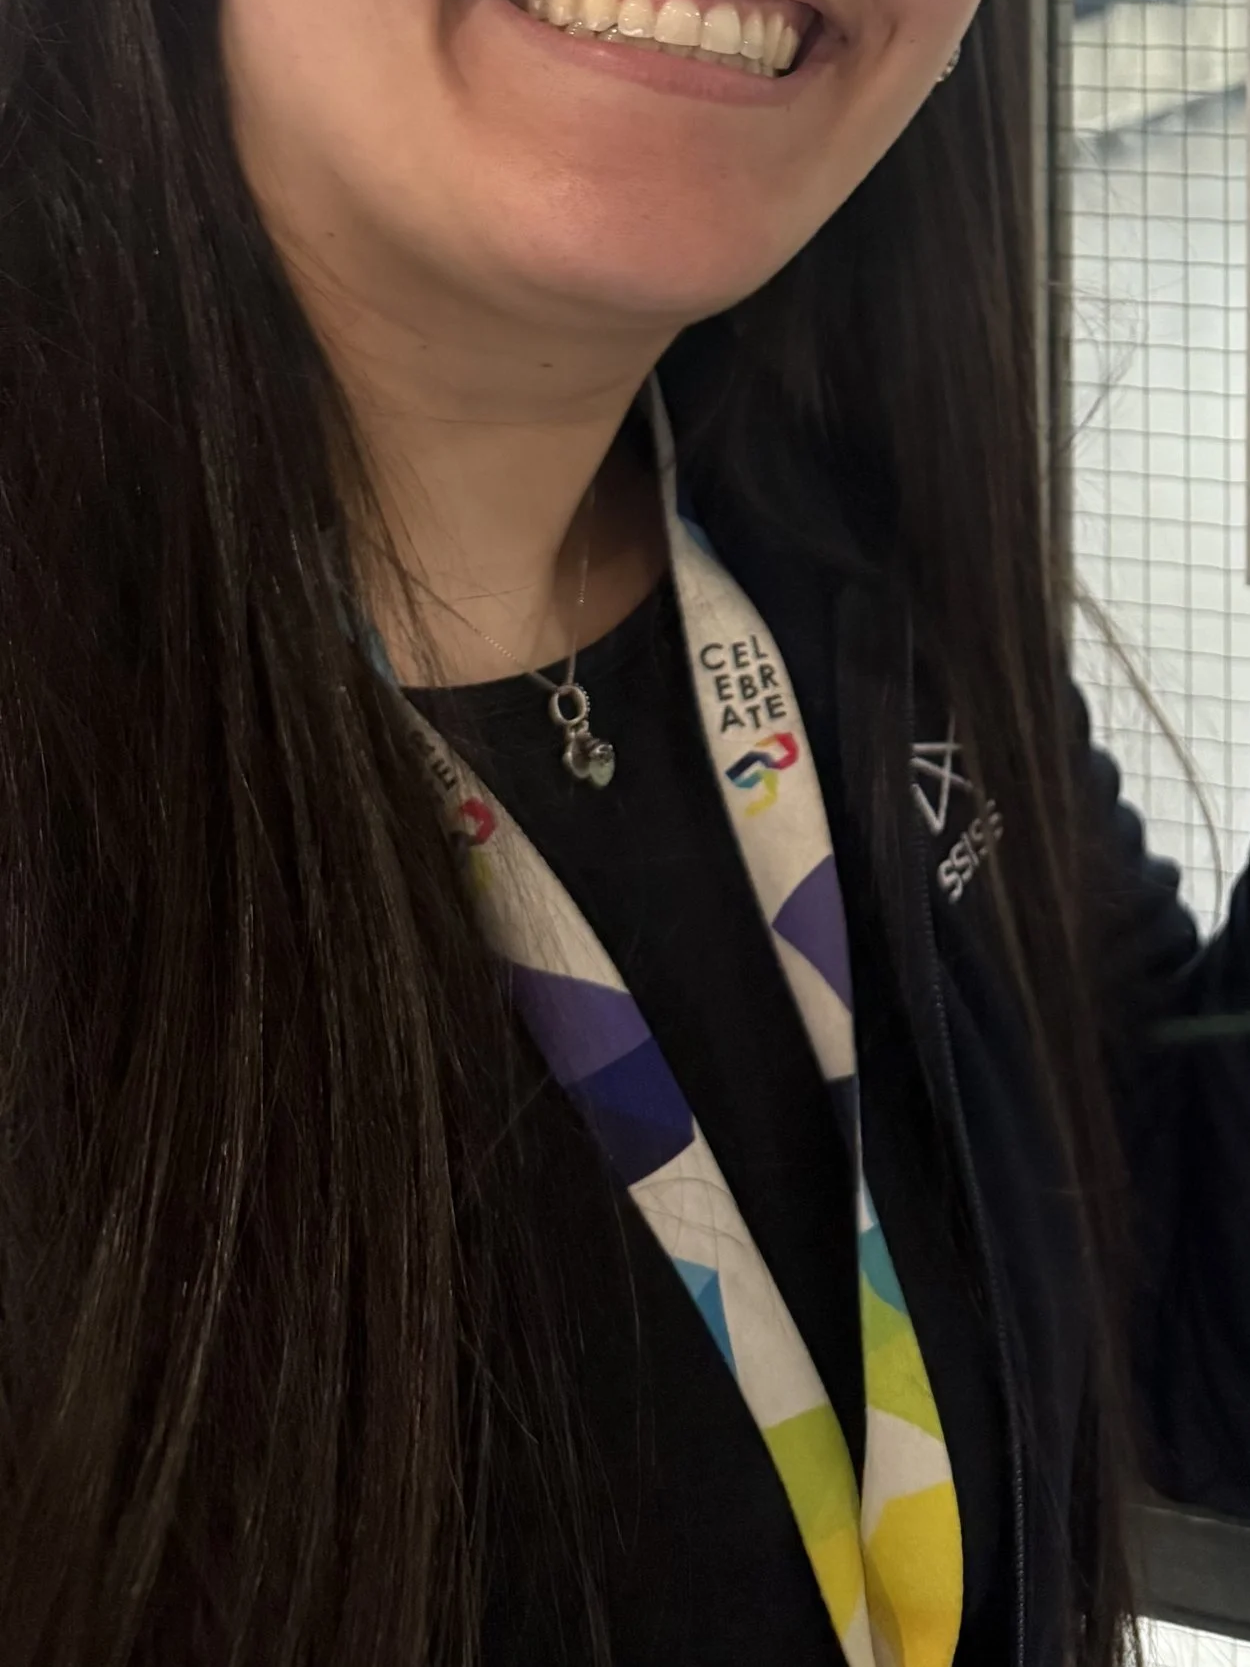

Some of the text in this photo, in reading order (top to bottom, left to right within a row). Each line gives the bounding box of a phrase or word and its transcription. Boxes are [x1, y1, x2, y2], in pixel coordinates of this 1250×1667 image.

[700, 635, 769, 672] CEL
[716, 662, 780, 702] EBR
[720, 694, 787, 733] ATE
